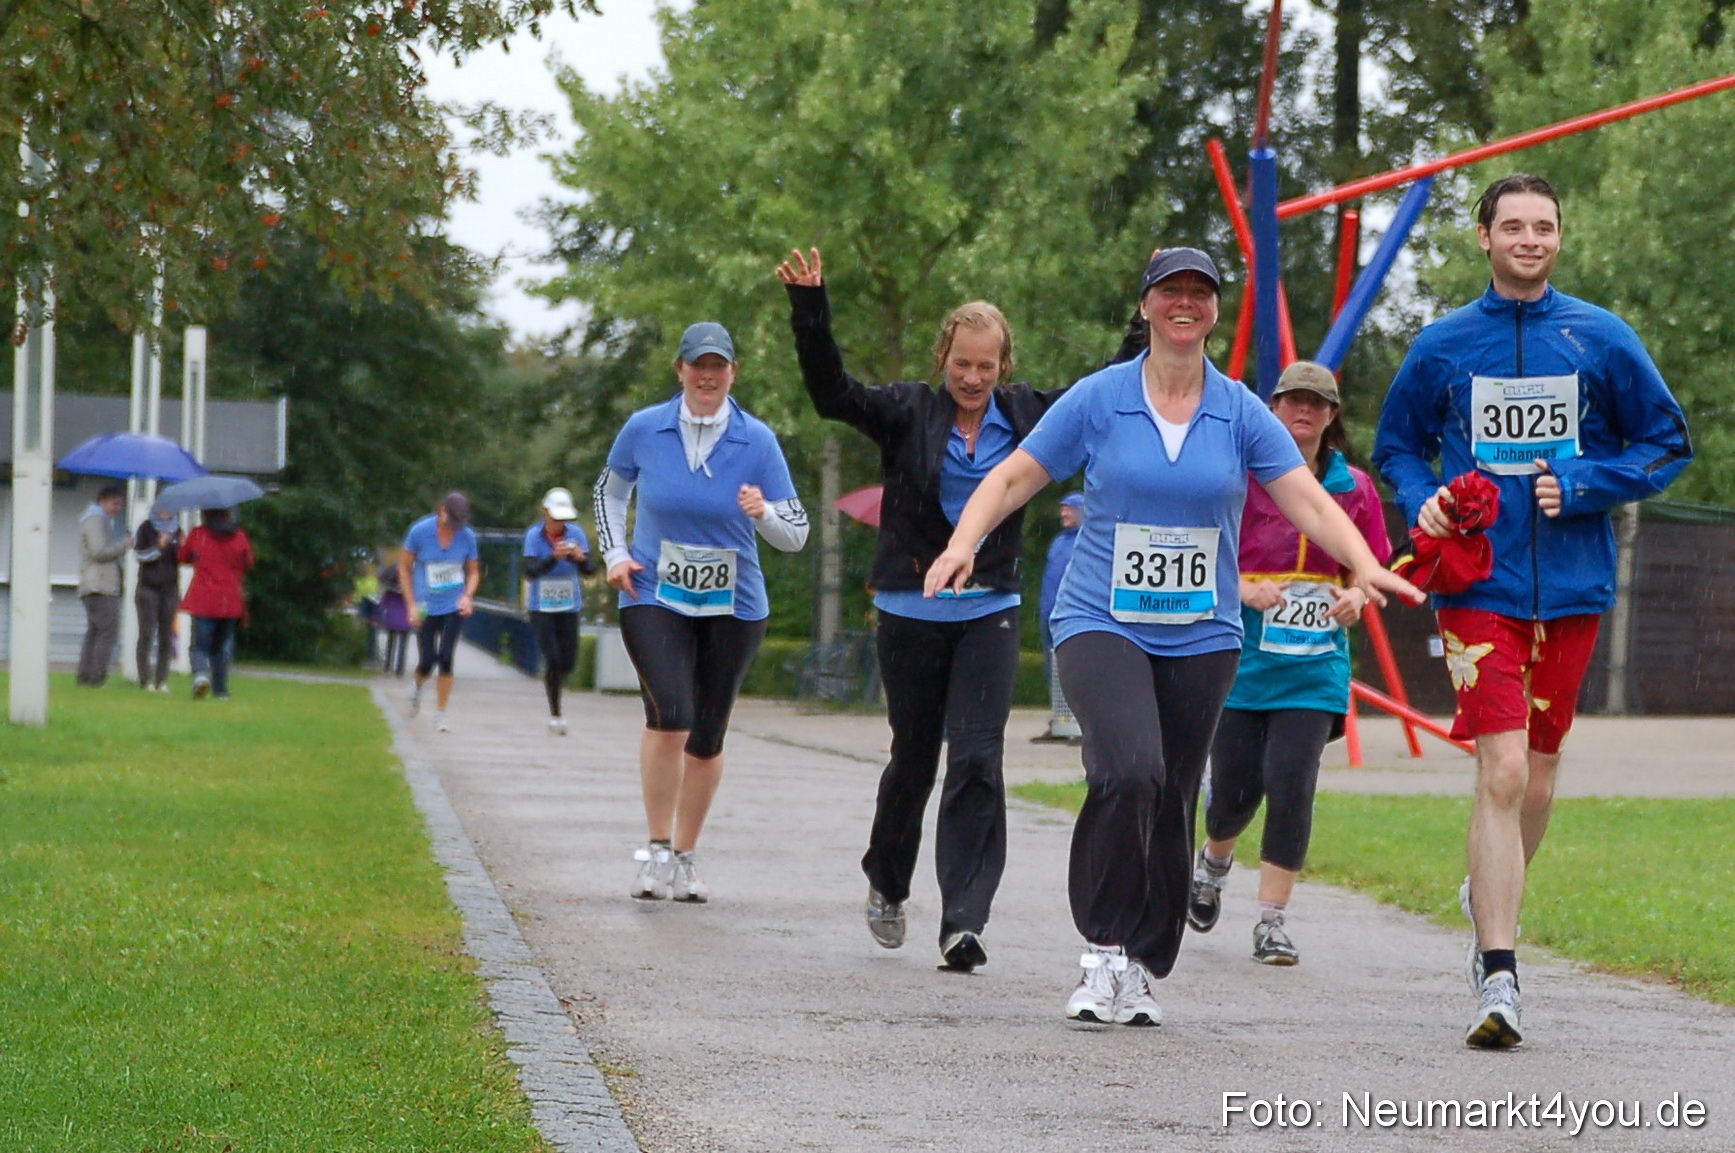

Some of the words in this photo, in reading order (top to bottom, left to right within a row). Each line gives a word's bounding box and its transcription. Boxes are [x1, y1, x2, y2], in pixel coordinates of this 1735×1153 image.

[1483, 403, 1568, 438] 3025
[1493, 447, 1557, 461] Johannes
[666, 562, 729, 590] 3028
[1124, 551, 1207, 588] 3316
[1139, 595, 1190, 610] Martina
[1272, 599, 1331, 629] 2283
